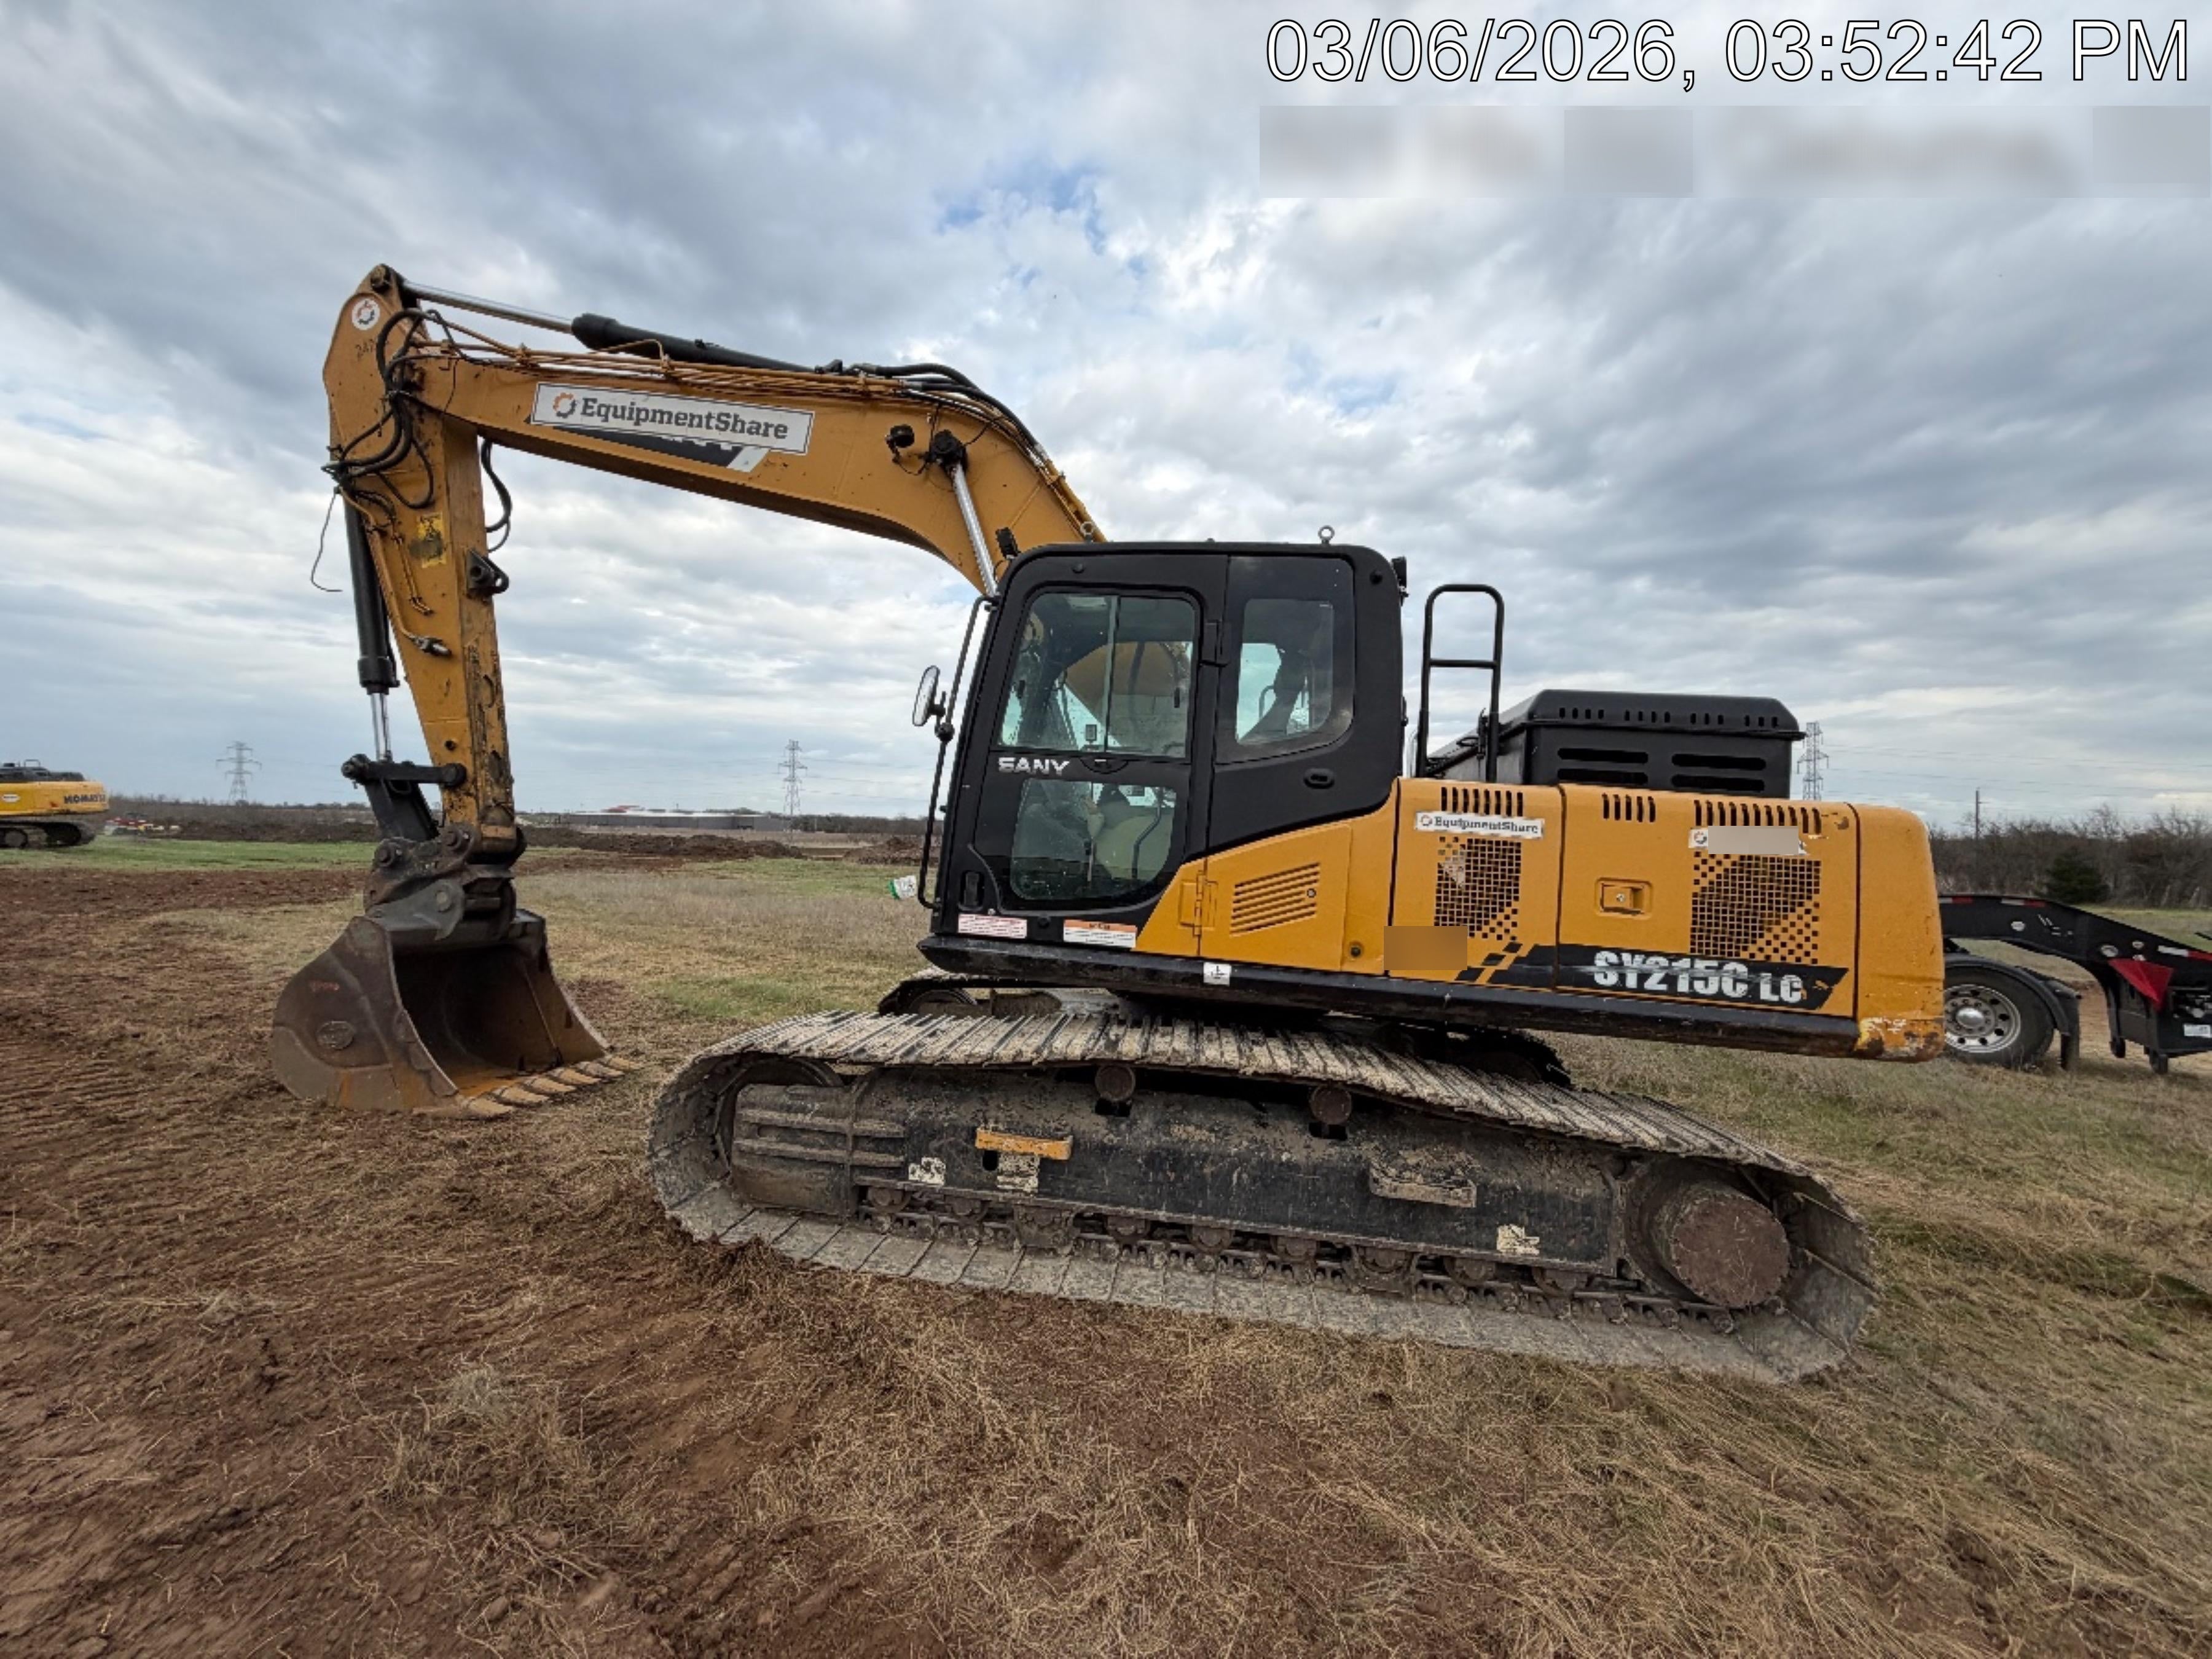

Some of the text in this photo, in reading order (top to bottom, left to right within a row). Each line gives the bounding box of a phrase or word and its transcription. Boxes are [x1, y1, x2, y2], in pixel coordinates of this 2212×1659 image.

[581, 397, 789, 439] EquipmentShare
[998, 757, 1070, 775] SANY
[1434, 815, 1538, 834] EquipmentShare
[1594, 951, 1803, 1003] SY215C LC
